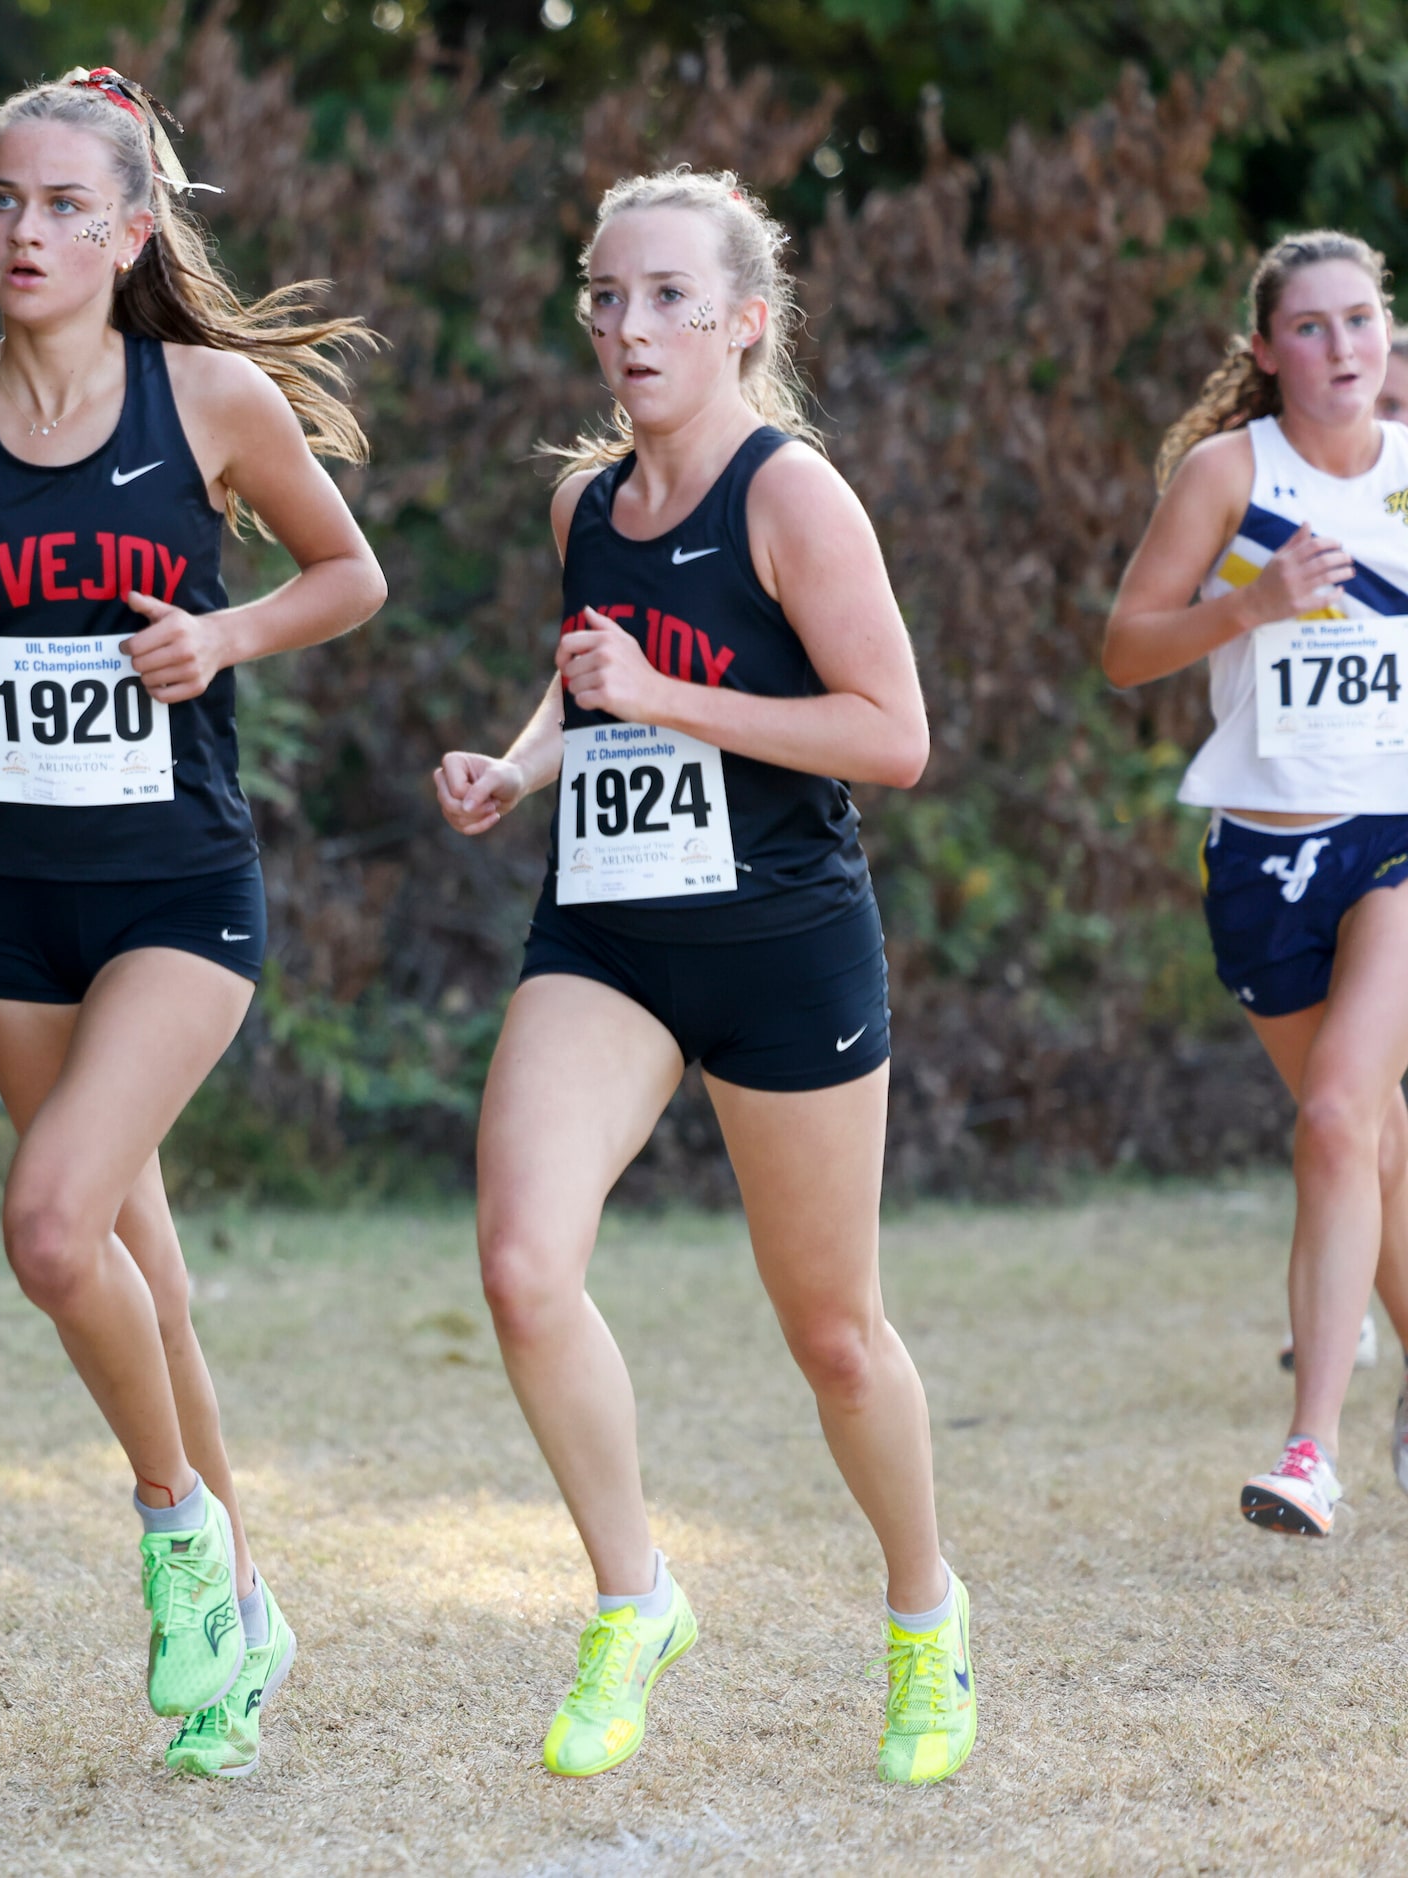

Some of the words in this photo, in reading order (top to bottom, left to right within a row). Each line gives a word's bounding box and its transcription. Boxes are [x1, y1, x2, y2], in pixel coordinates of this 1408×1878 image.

[25, 642, 44, 655] UIL
[48, 641, 90, 656] Region
[95, 641, 103, 653] II
[14, 660, 30, 672] XC
[33, 658, 121, 674] Championship
[1271, 653, 1401, 707] 1784
[595, 730, 608, 742] UIL
[611, 727, 646, 742] Region
[650, 725, 657, 738] II
[586, 750, 597, 762] XC
[599, 744, 675, 761] Championship
[38, 762, 108, 773] ARLINGTON
[571, 762, 712, 839] 1924
[601, 851, 668, 866] ARLINGTON
